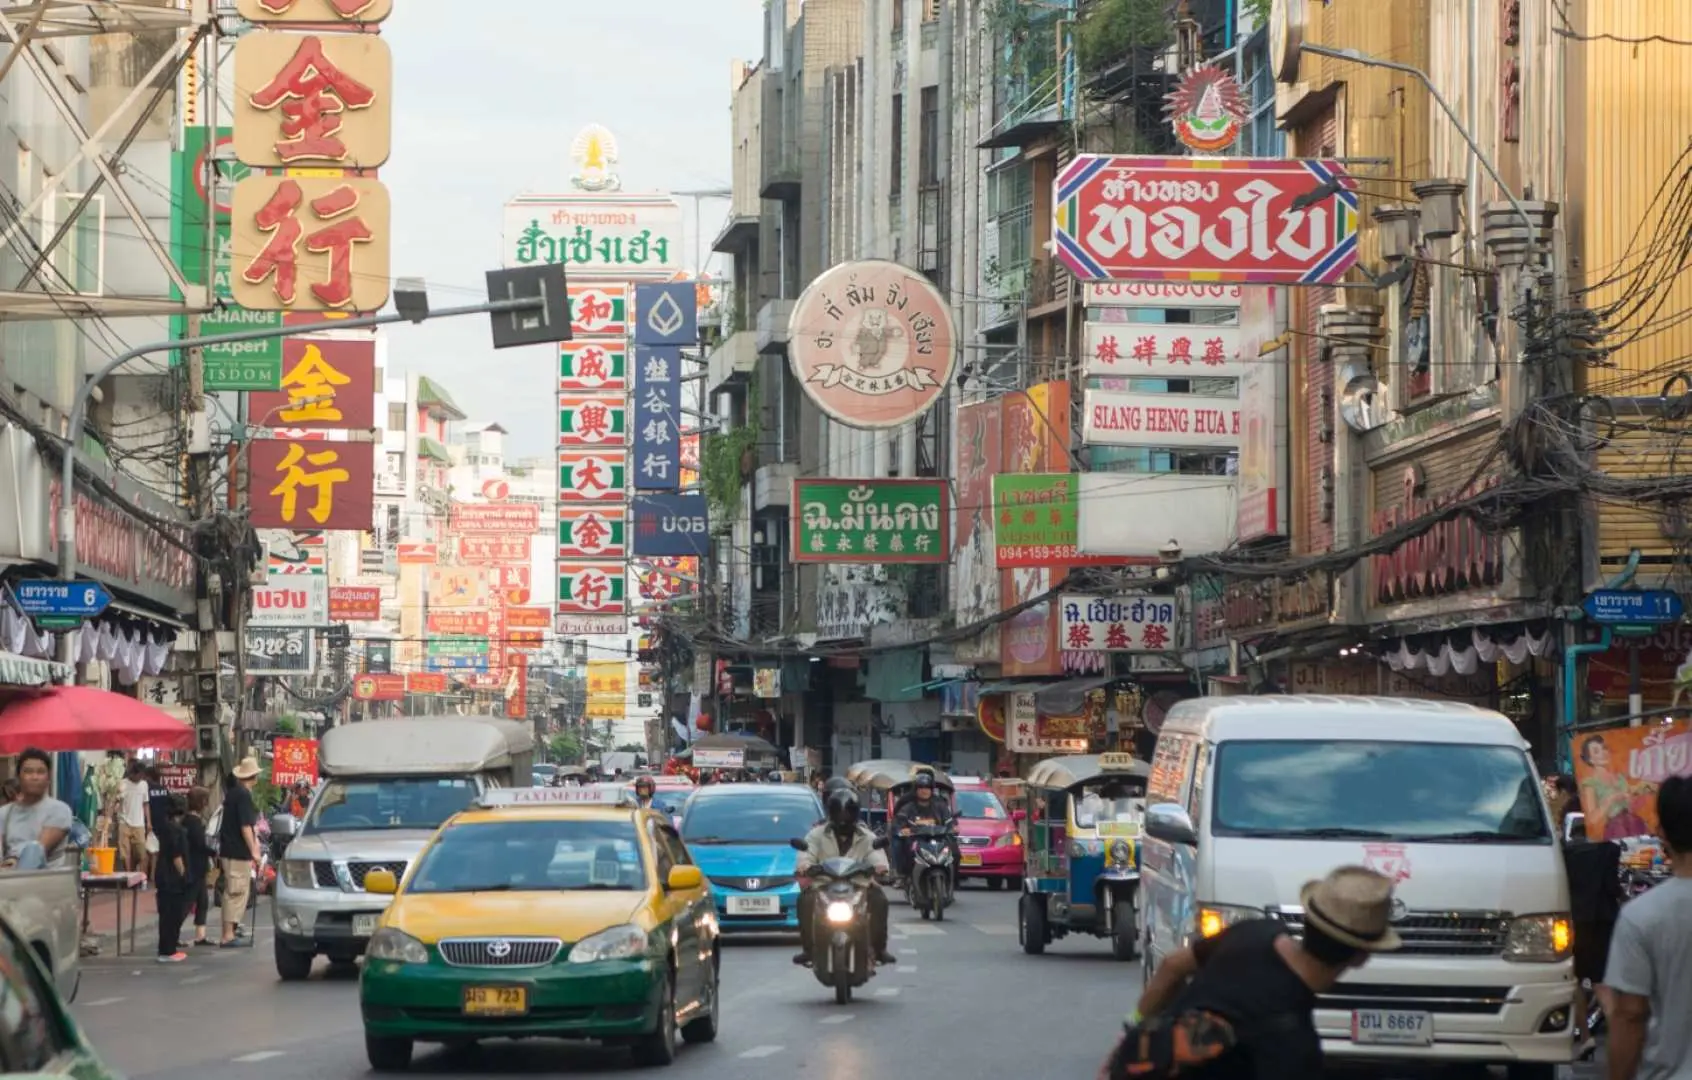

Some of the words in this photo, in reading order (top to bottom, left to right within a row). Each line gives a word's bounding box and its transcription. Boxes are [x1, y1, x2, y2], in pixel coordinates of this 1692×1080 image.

[1102, 168, 1219, 202] ห้างทอง
[1087, 179, 1329, 262] ทองใบ
[1095, 335, 1240, 366] 林祥興藥
[208, 368, 272, 381] ISDOM
[1094, 405, 1141, 431] SIANG
[1146, 407, 1189, 433] HENG
[1194, 409, 1227, 434] HUA
[270, 343, 351, 524] 金行
[803, 484, 939, 530] ฉ.มั่นคง
[662, 516, 706, 533] UOB
[20, 586, 68, 598] เยาวราช
[84, 588, 96, 606] 6
[1105, 754, 1128, 763] TAXI
[496, 988, 521, 1003] 723
[1387, 1013, 1425, 1030] 8667
